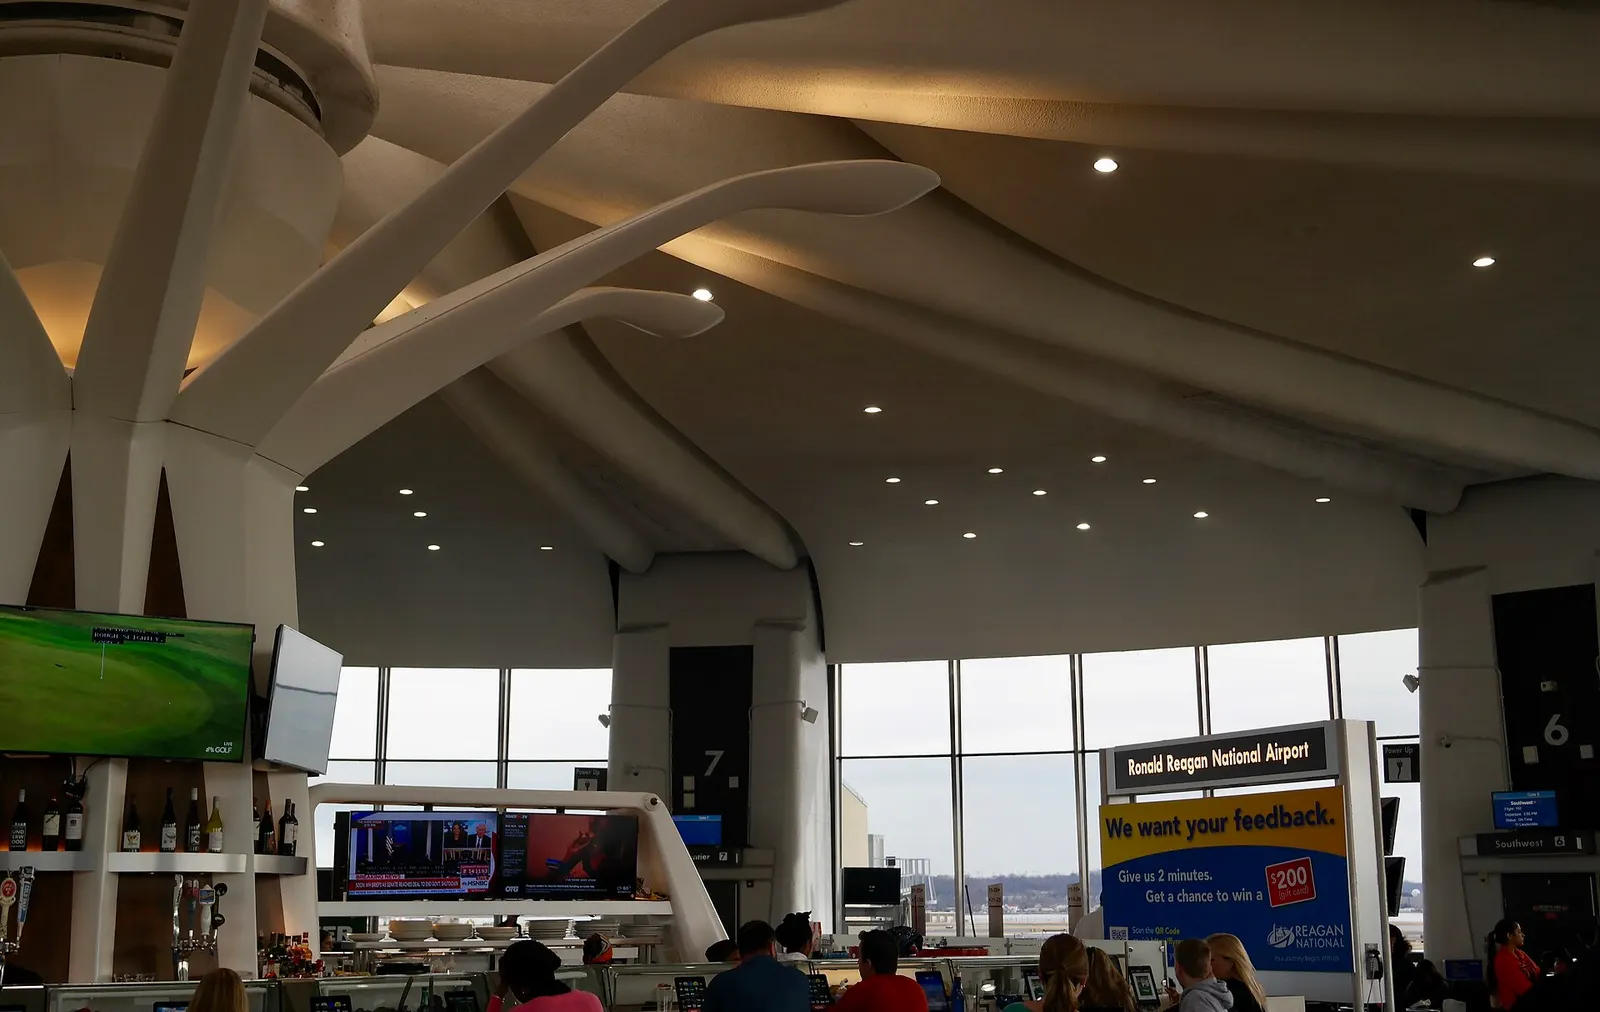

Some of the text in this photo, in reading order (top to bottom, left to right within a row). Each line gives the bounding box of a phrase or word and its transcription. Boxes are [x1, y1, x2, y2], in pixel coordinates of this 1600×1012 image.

[1544, 714, 1569, 746] 6
[1404, 747, 1413, 755] Up
[704, 750, 724, 776] 7
[1128, 742, 1309, 776] Ronald Reagan National Airport
[592, 769, 600, 778] Up
[1106, 801, 1335, 841] We want your feedback.
[1495, 838, 1544, 848] Southwest
[1118, 869, 1212, 882] Give us 2 minutes.
[1271, 866, 1307, 890] $200
[1146, 888, 1263, 903] Get a chance to win a
[1155, 926, 1164, 934] QR
[1165, 926, 1180, 934] Code
[1295, 924, 1344, 937] REAGAN
[1296, 938, 1344, 948] NATIONAL
